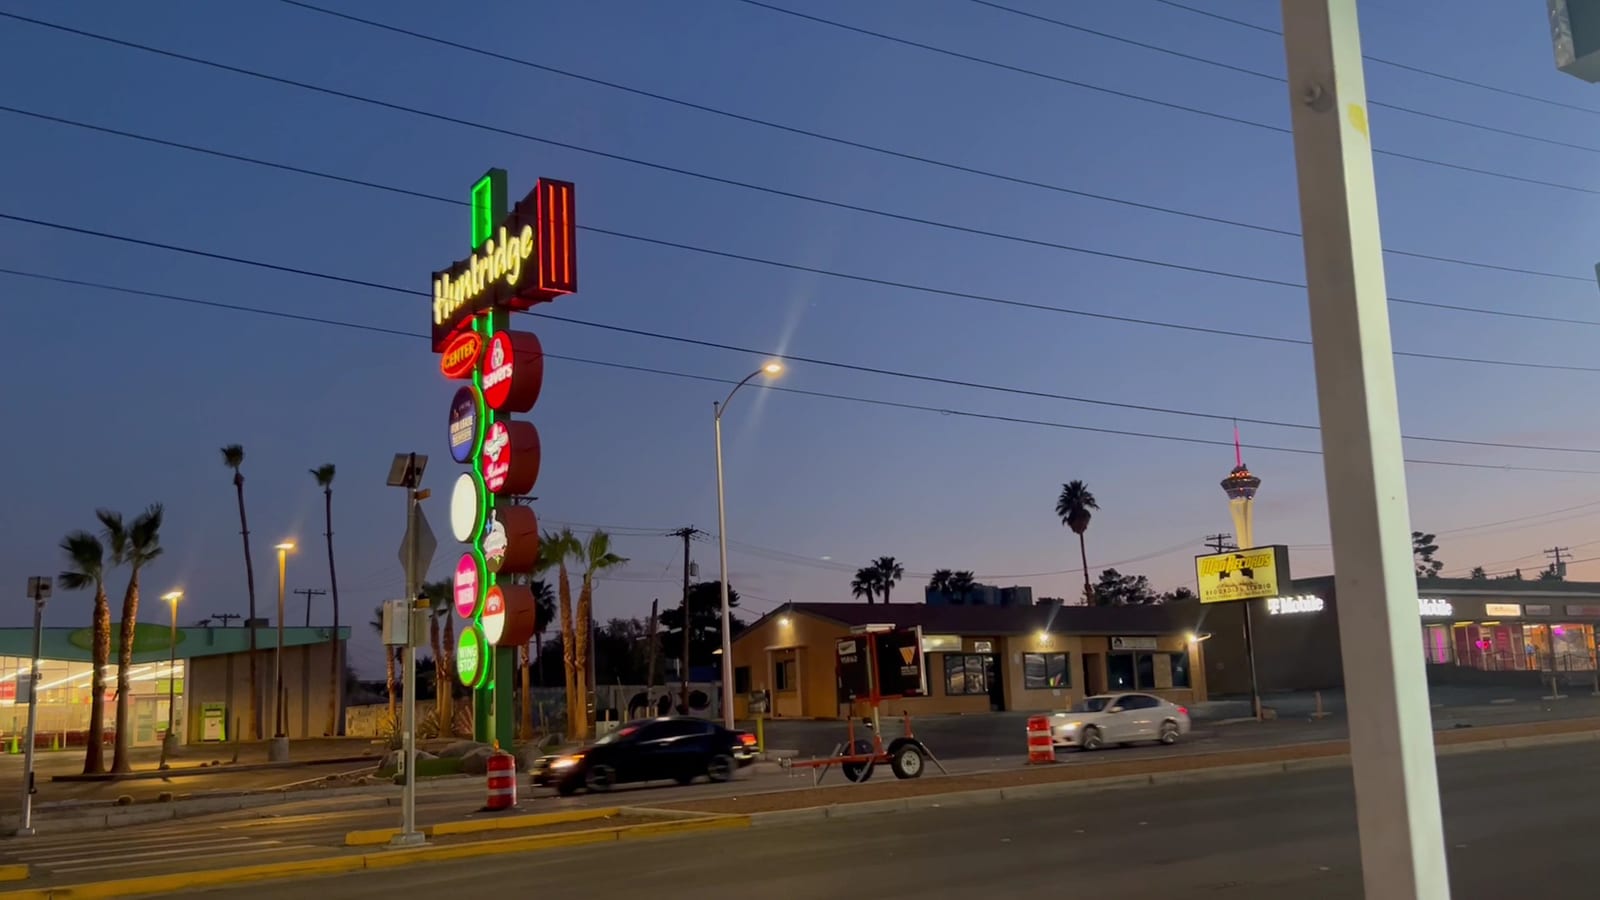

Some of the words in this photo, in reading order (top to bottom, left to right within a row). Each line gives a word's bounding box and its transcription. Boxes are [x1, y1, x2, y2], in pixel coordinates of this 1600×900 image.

[432, 224, 534, 326] Huntridge
[443, 338, 475, 370] CENTER
[482, 363, 513, 390] savers
